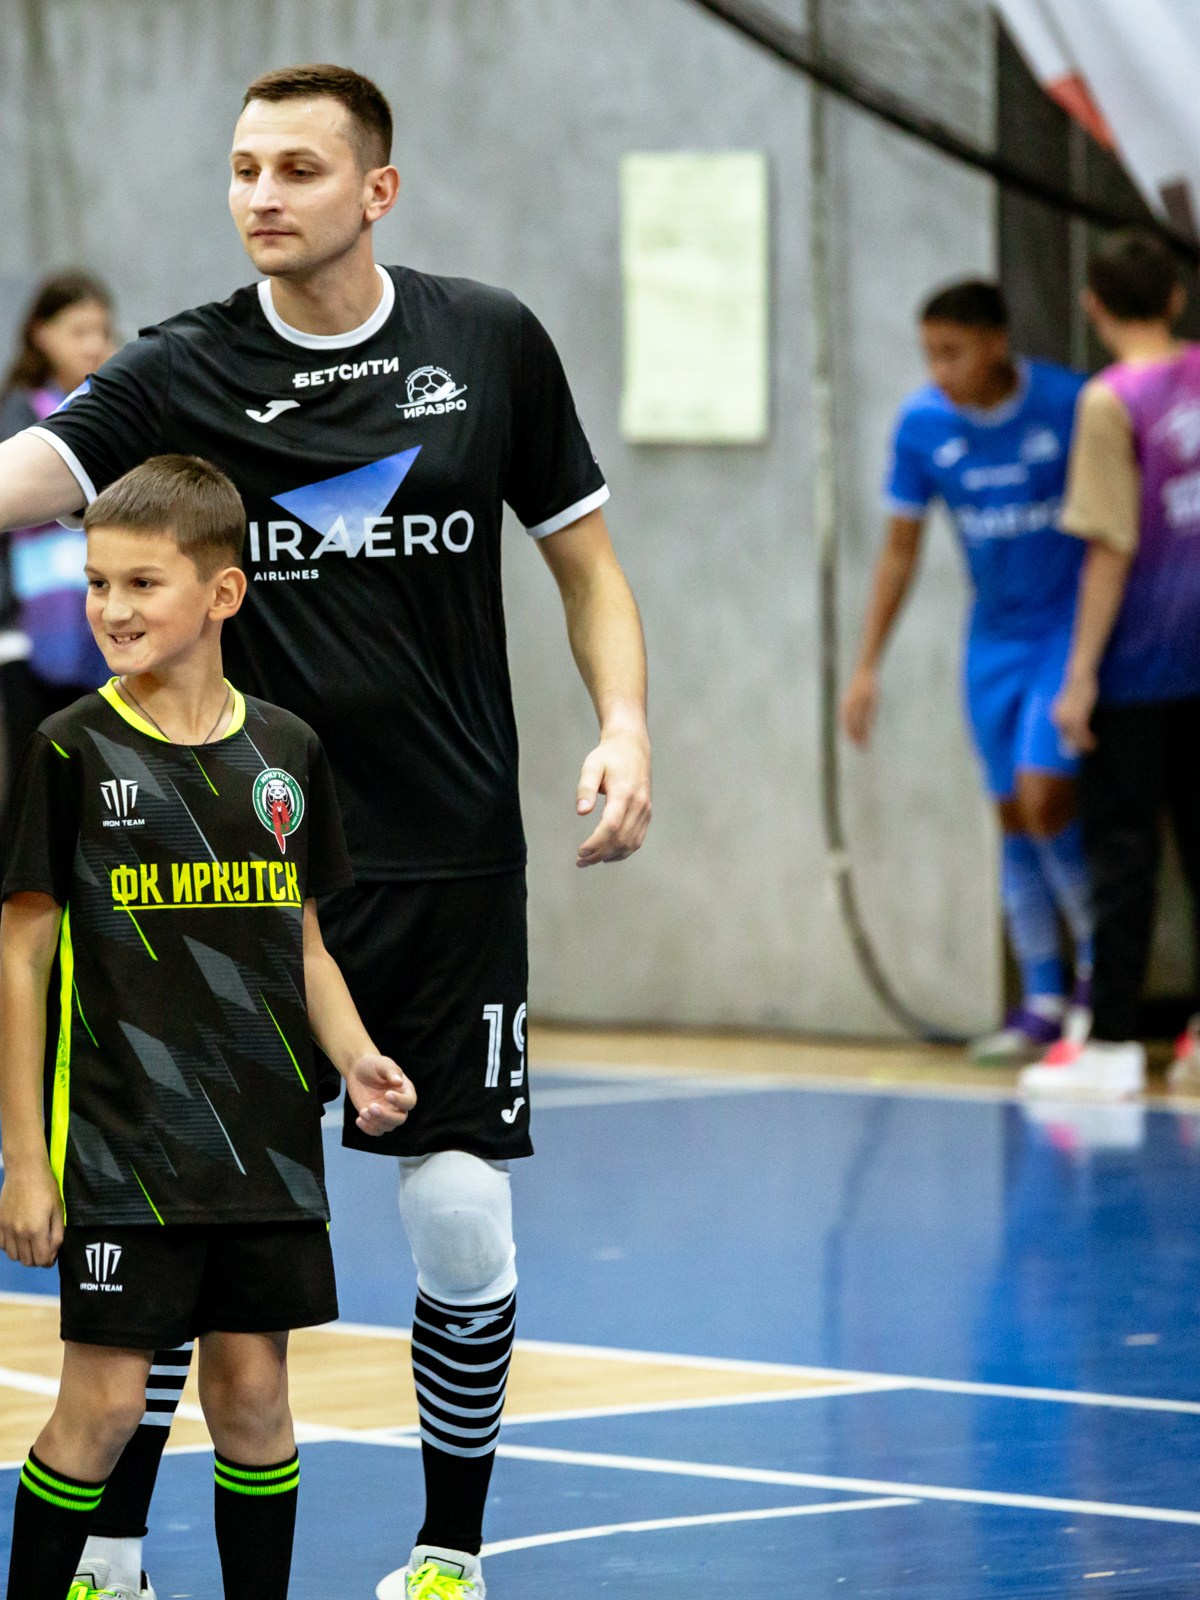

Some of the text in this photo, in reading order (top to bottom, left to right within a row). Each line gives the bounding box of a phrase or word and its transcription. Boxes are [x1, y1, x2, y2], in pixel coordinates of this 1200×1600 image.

[292, 356, 399, 389] БЕТСИТИ
[403, 399, 467, 419] ИРАЭРО
[248, 509, 475, 562] IRAERO
[253, 568, 320, 582] AIRLINES
[121, 818, 145, 826] TEAM
[111, 861, 301, 904] ФК ИРКУТСК
[80, 1282, 123, 1292] IRON TEAM
